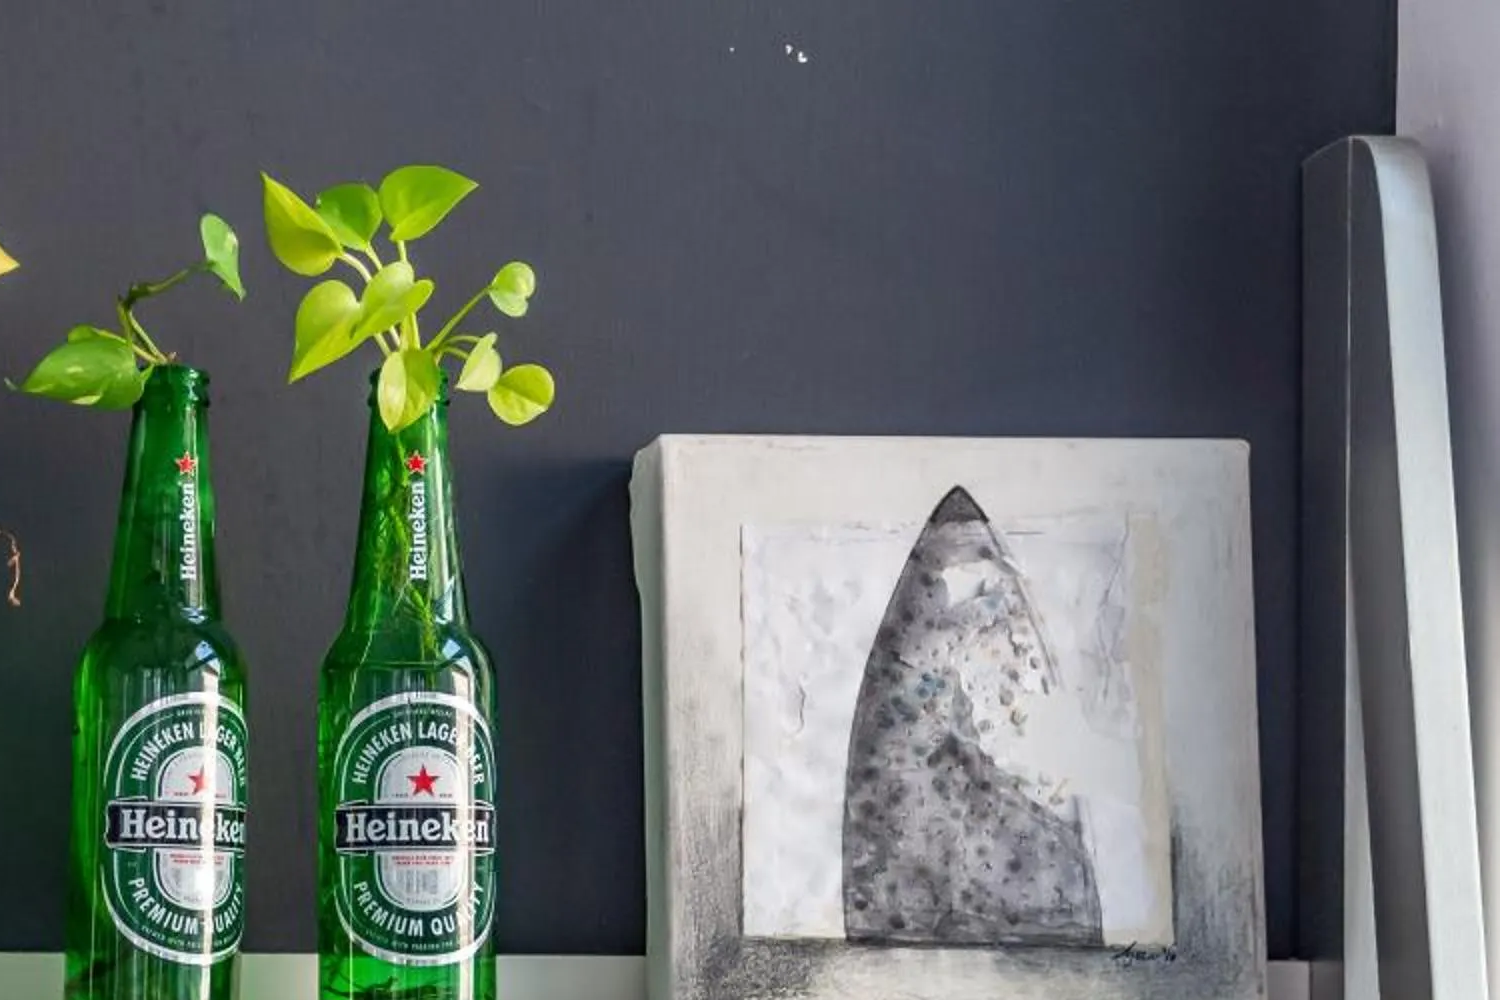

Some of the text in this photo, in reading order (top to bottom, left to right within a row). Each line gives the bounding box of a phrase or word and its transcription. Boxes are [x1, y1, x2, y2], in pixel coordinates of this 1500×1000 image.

[180, 483, 197, 580] Heineken
[408, 481, 428, 580] Heineken
[130, 721, 195, 781] HEINEKEN
[199, 722, 237, 752] LGER
[351, 721, 413, 784] HEINEKEN
[419, 721, 464, 748] LAGE
[119, 809, 245, 843] Heinke
[345, 811, 490, 843] Heineken
[128, 878, 243, 935] PREMIUM UALITY
[353, 879, 484, 937] PREMIUM QUTY
